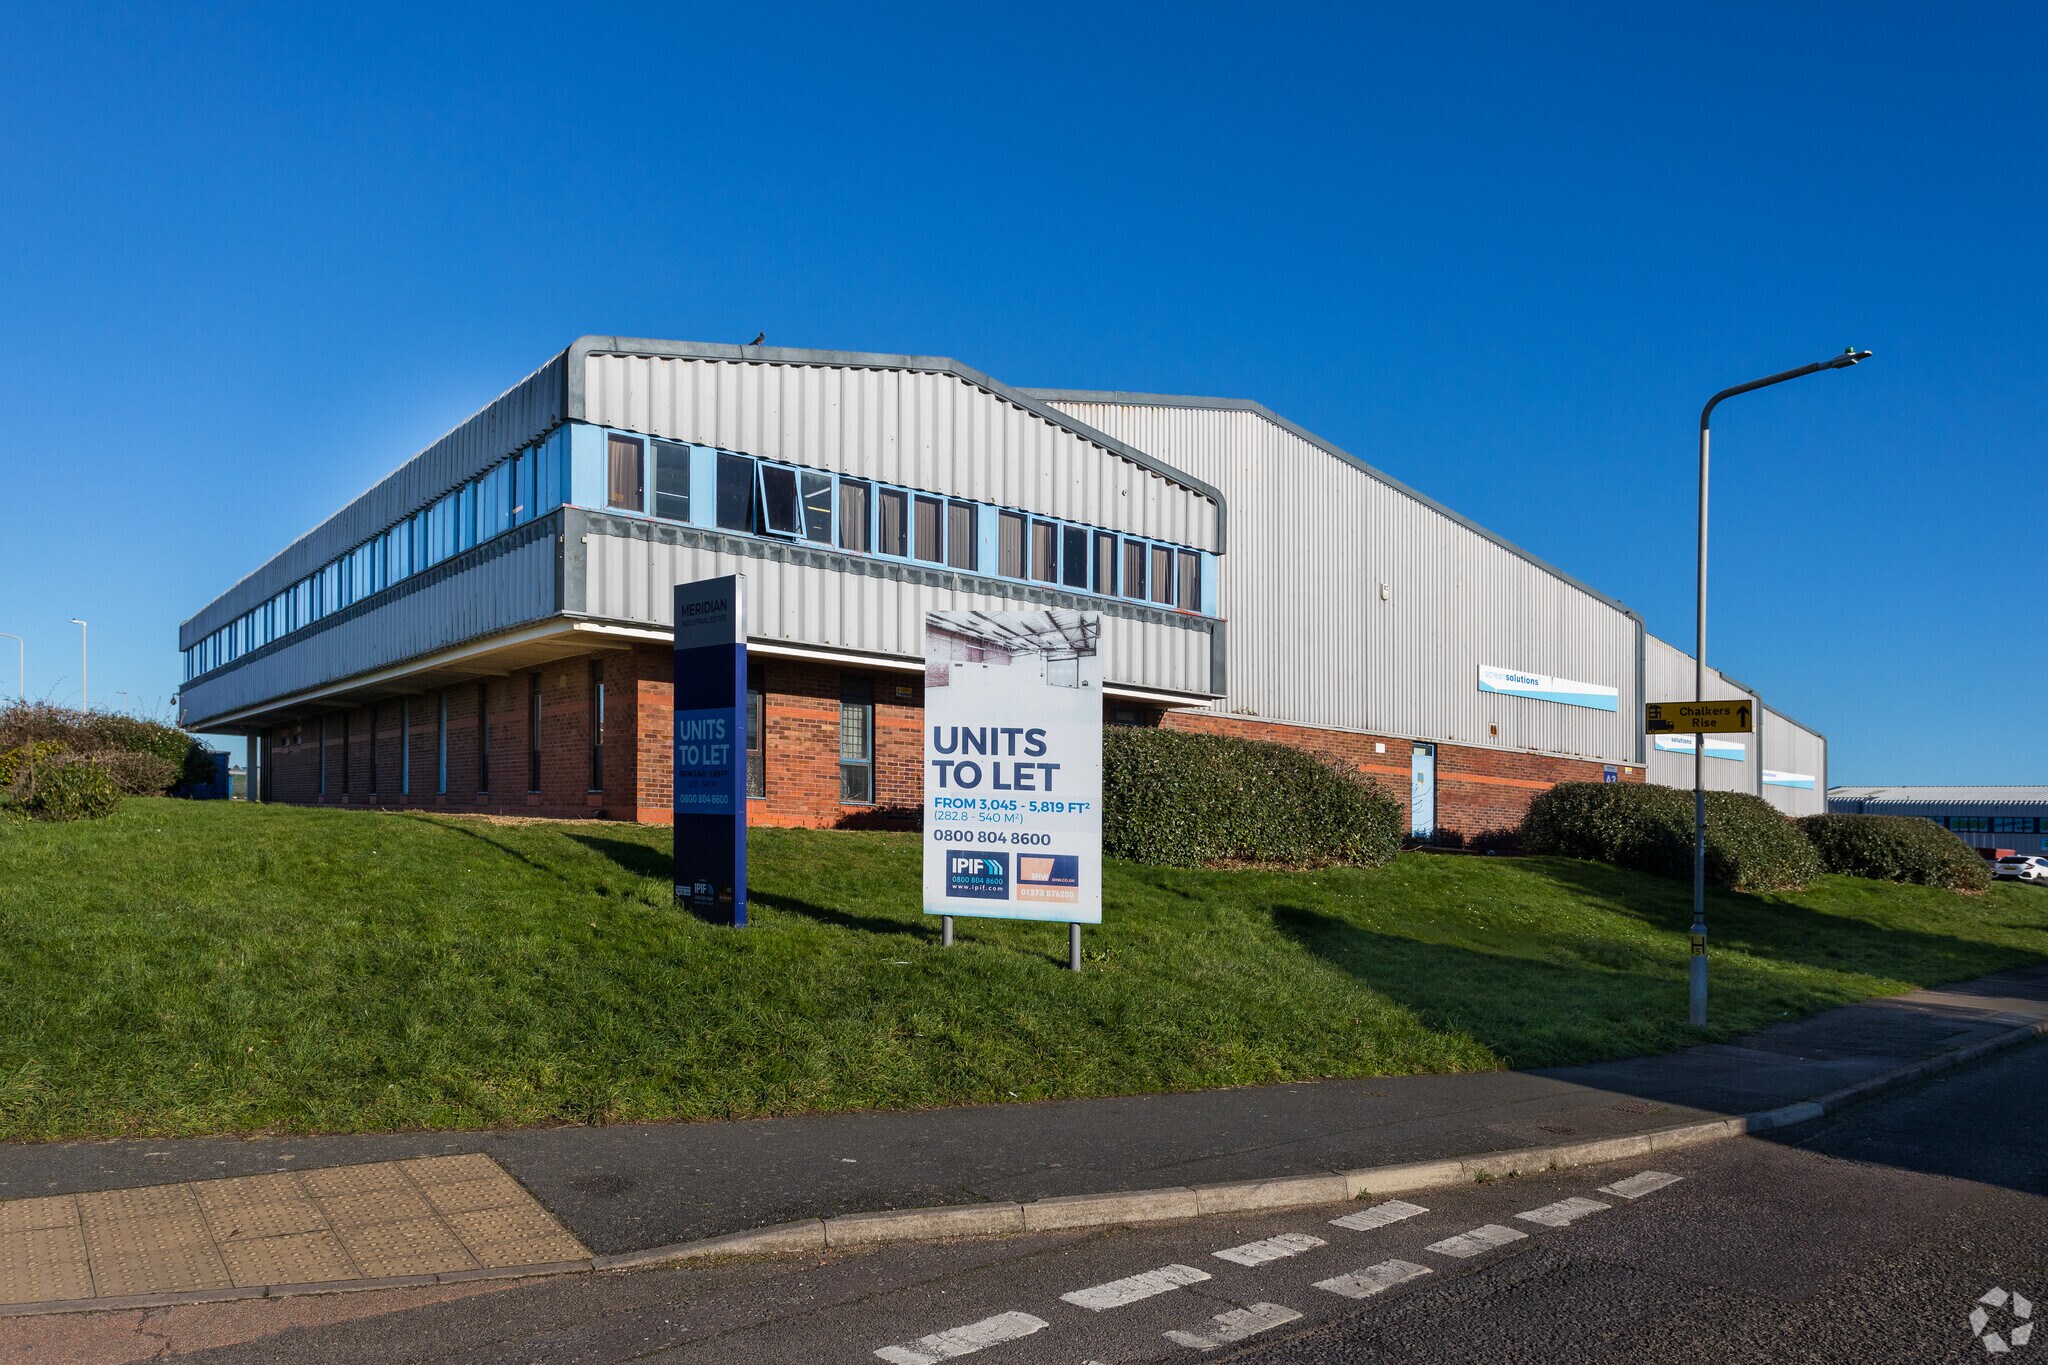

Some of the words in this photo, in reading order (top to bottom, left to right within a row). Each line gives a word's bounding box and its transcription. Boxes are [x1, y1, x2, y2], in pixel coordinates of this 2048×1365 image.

[681, 598, 728, 618] MERIDIAN
[681, 618, 709, 628] INDUSTRIAL
[709, 614, 728, 624] ESTATE
[1680, 706, 1731, 716] Chalkers
[680, 718, 726, 740] UNITS
[1692, 718, 1717, 727] Rise
[933, 726, 1047, 757] UNITS
[679, 744, 699, 766] TO
[702, 743, 730, 765] LET
[931, 759, 983, 789] TO
[992, 761, 1061, 792] LET
[680, 794, 697, 803] 0800
[697, 794, 711, 803] 804
[711, 794, 729, 804] 8600
[934, 797, 976, 809] FROM
[979, 798, 1017, 813] 3,045
[1028, 801, 1064, 814] 5,819
[934, 810, 968, 821] (282.8
[978, 812, 1001, 822] 540
[1004, 813, 1023, 824] M²)
[933, 829, 974, 842] 0800
[977, 831, 1008, 844] 804
[1010, 832, 1051, 846] 8600
[952, 858, 984, 874] IPIF
[694, 882, 707, 894] IPIF
[951, 875, 970, 883] 0800
[985, 877, 1004, 885] 8600
